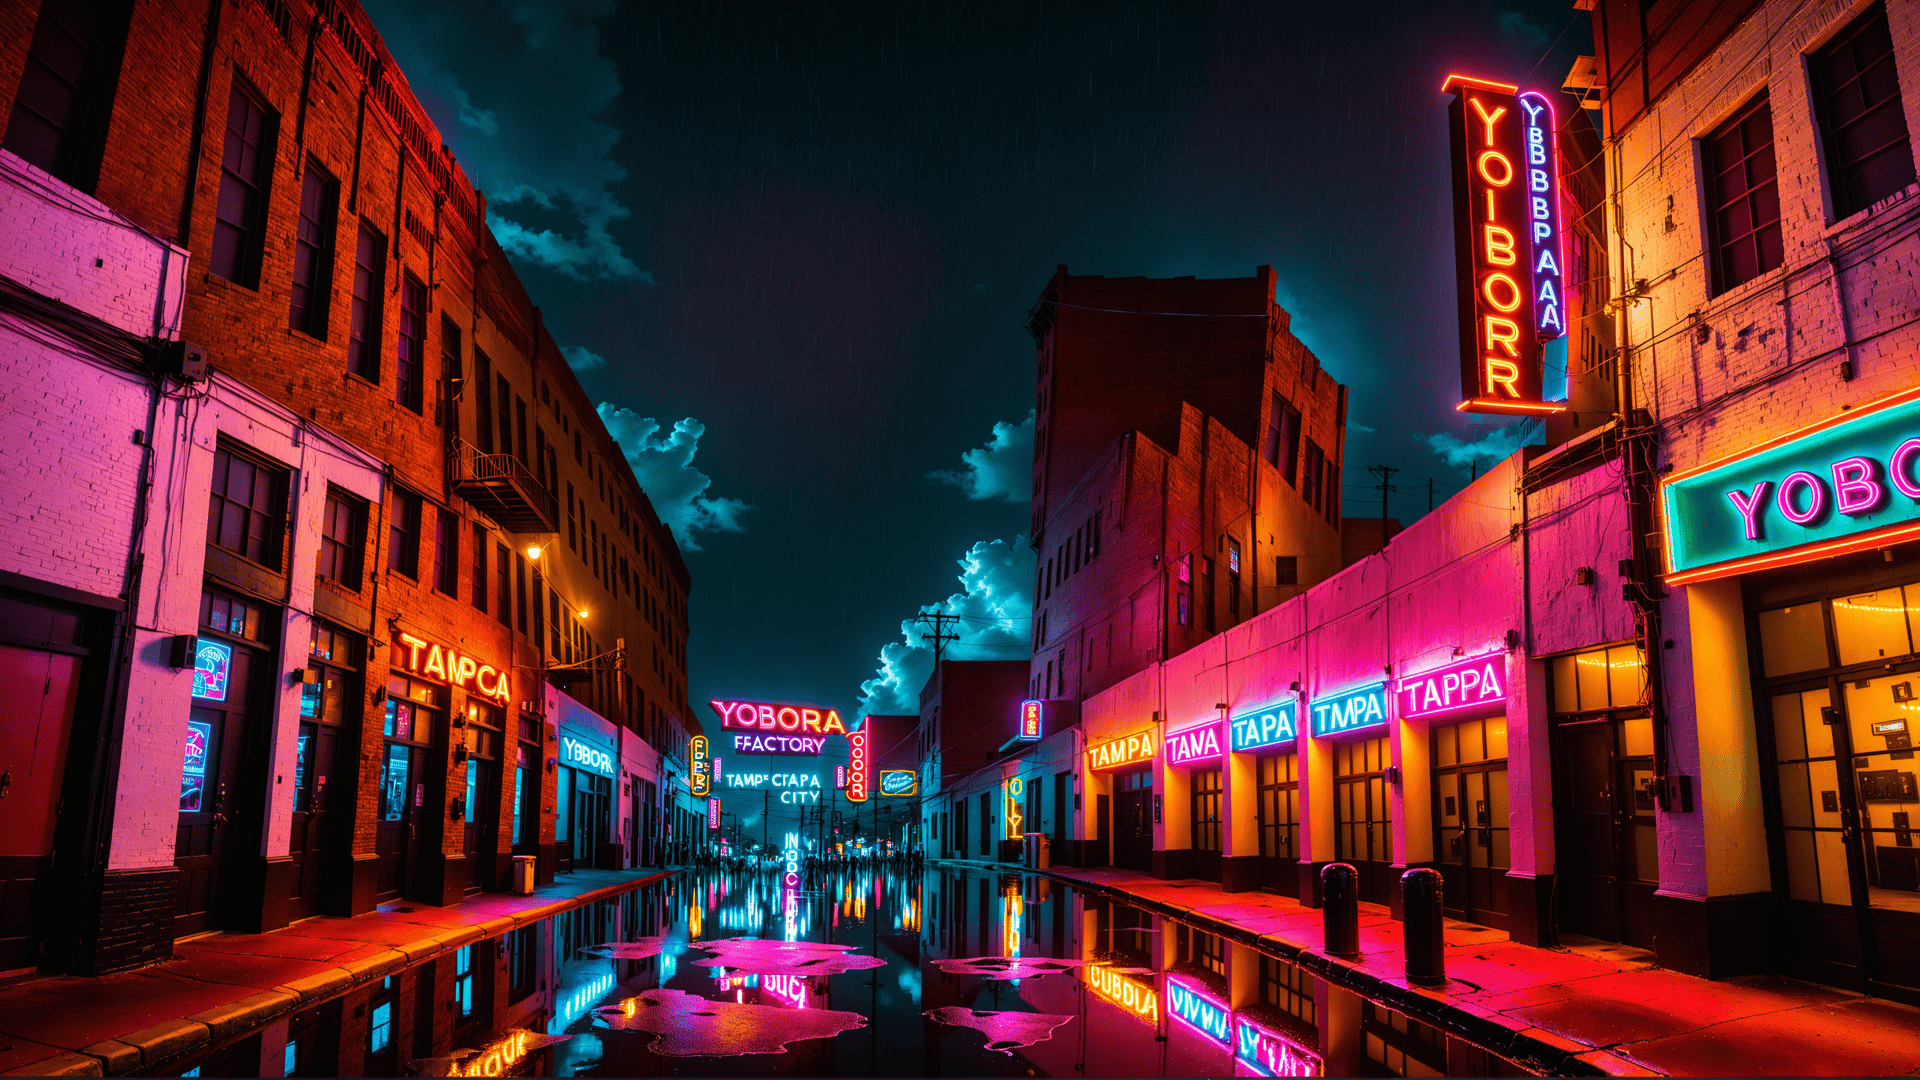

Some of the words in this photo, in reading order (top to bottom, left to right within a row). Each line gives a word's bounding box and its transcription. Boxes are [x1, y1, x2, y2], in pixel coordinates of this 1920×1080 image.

[1470, 97, 1521, 398] YOIBORR
[1404, 663, 1502, 712] TAPPA
[711, 701, 845, 734] YOBORA
[1233, 710, 1293, 746] TAPA
[1315, 694, 1382, 731] TMPA
[851, 735, 864, 797] OOOOR
[1089, 733, 1152, 767] TAMPA
[781, 791, 820, 804] CITY
